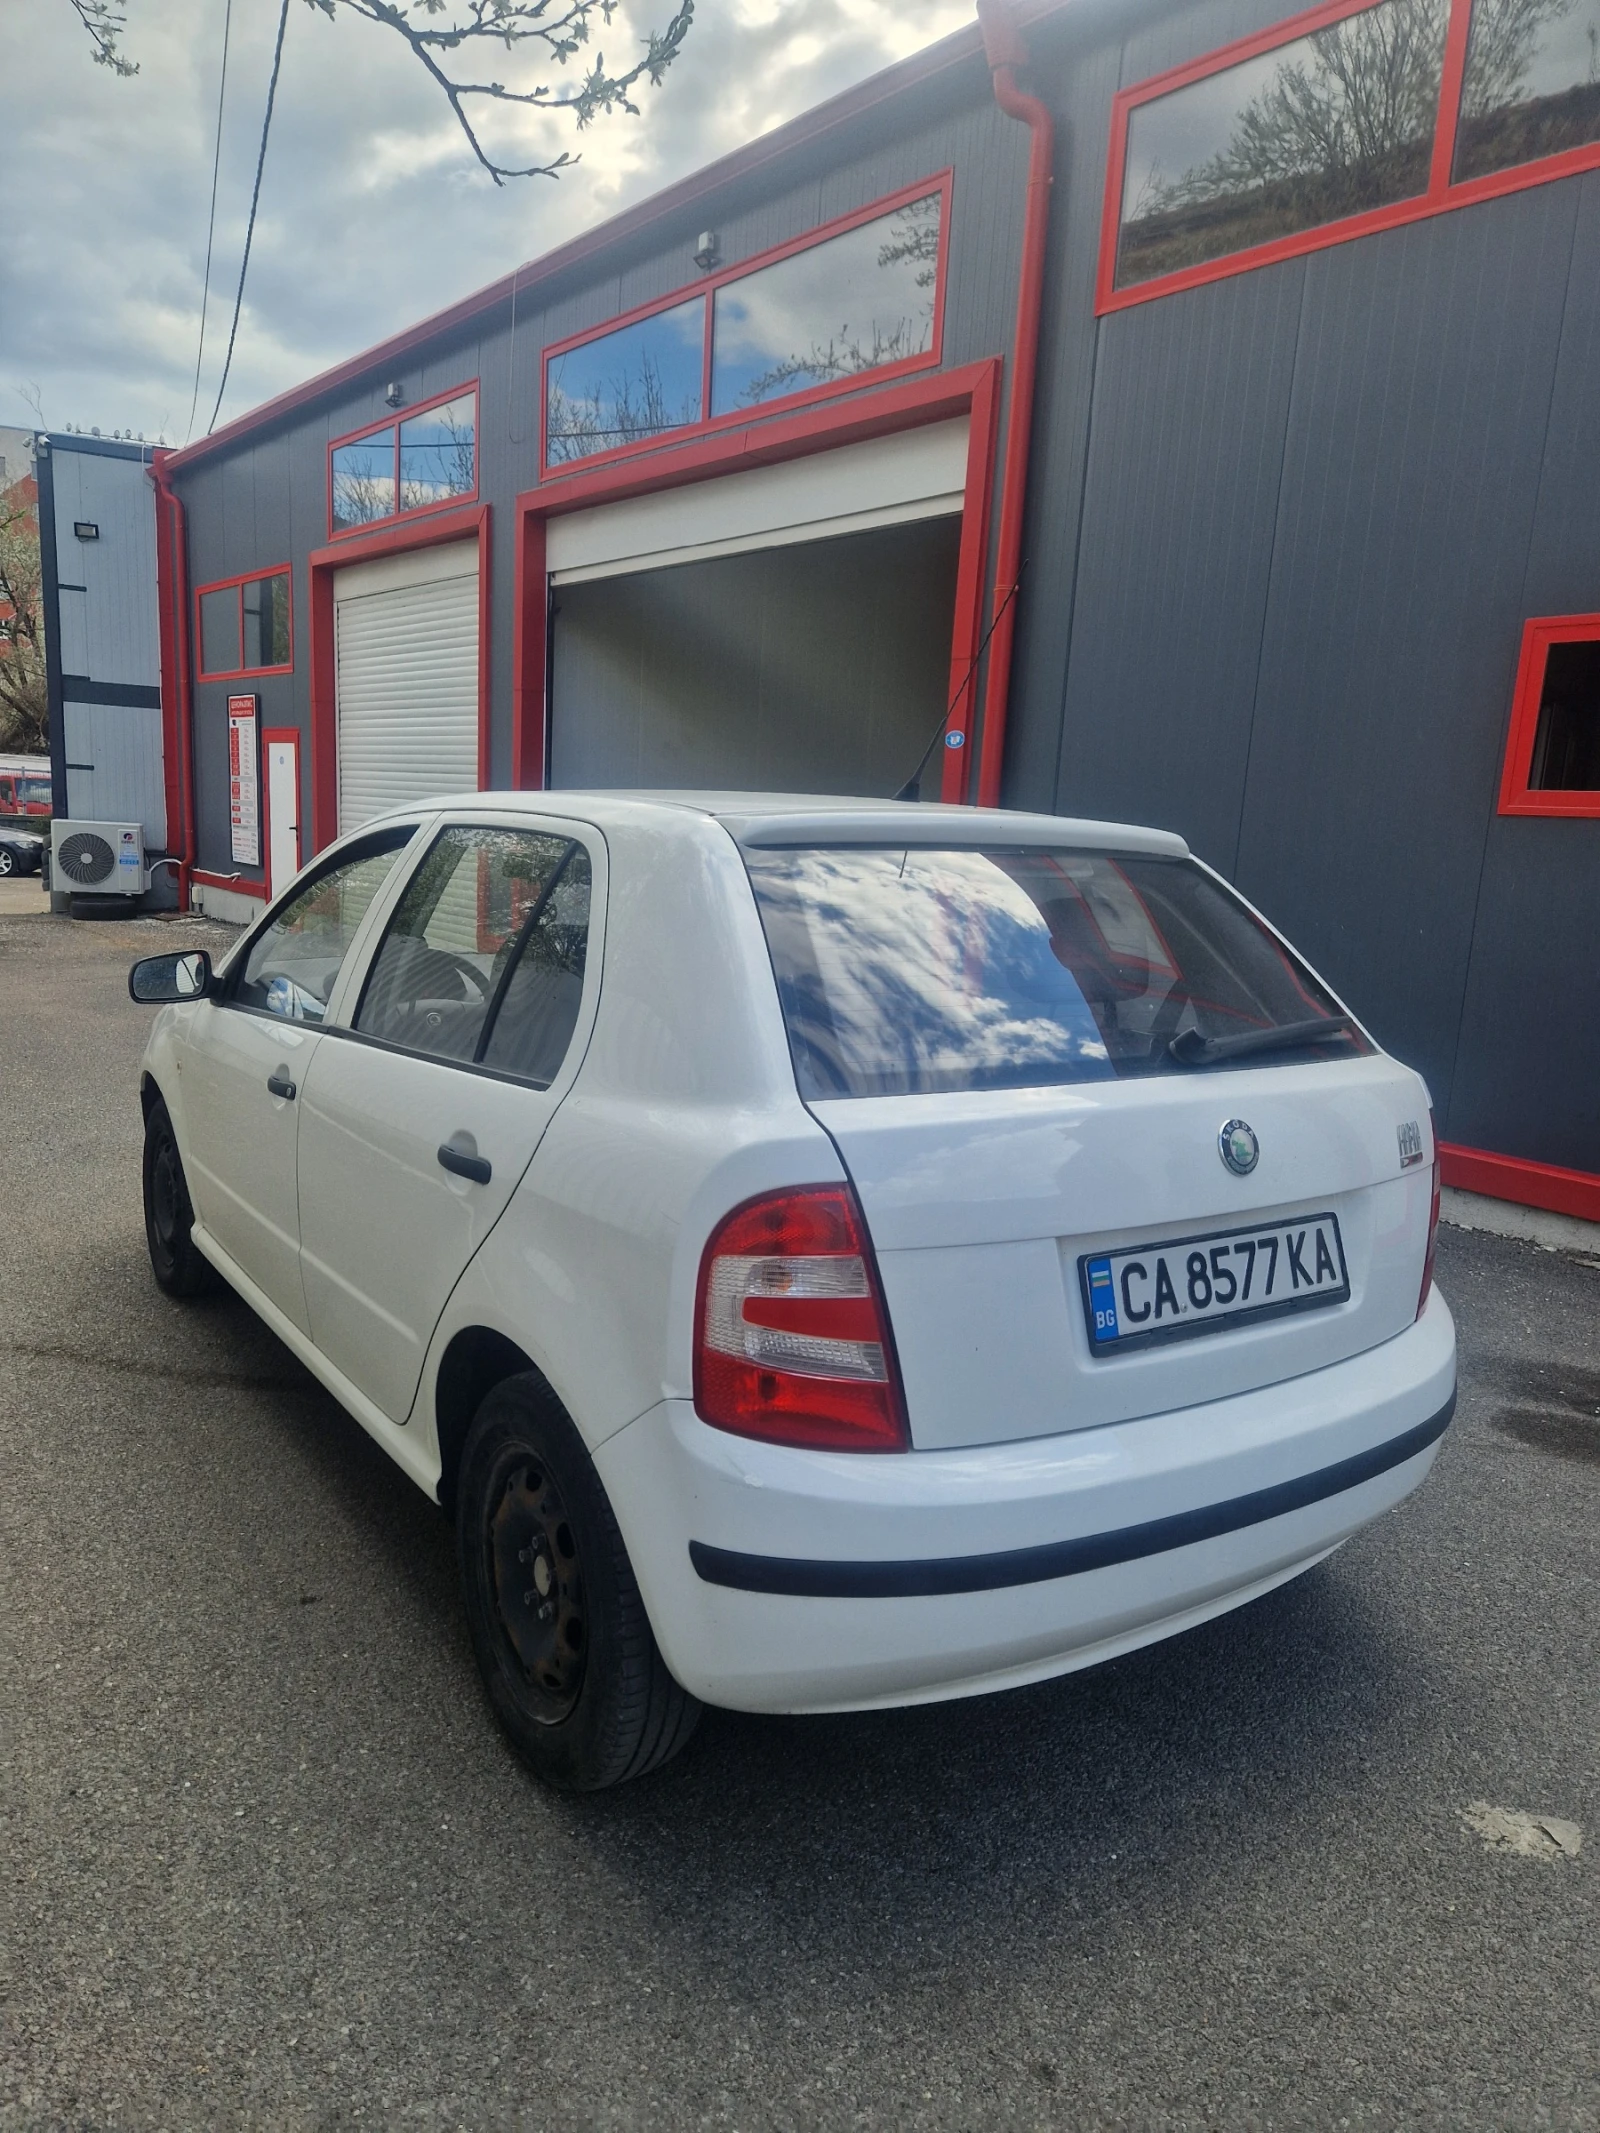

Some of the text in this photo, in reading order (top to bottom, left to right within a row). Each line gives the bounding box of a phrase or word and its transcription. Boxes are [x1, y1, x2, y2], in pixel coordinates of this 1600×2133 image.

[1120, 1228, 1337, 1323] CA 8577 KA
[1095, 1309, 1115, 1330] BG
